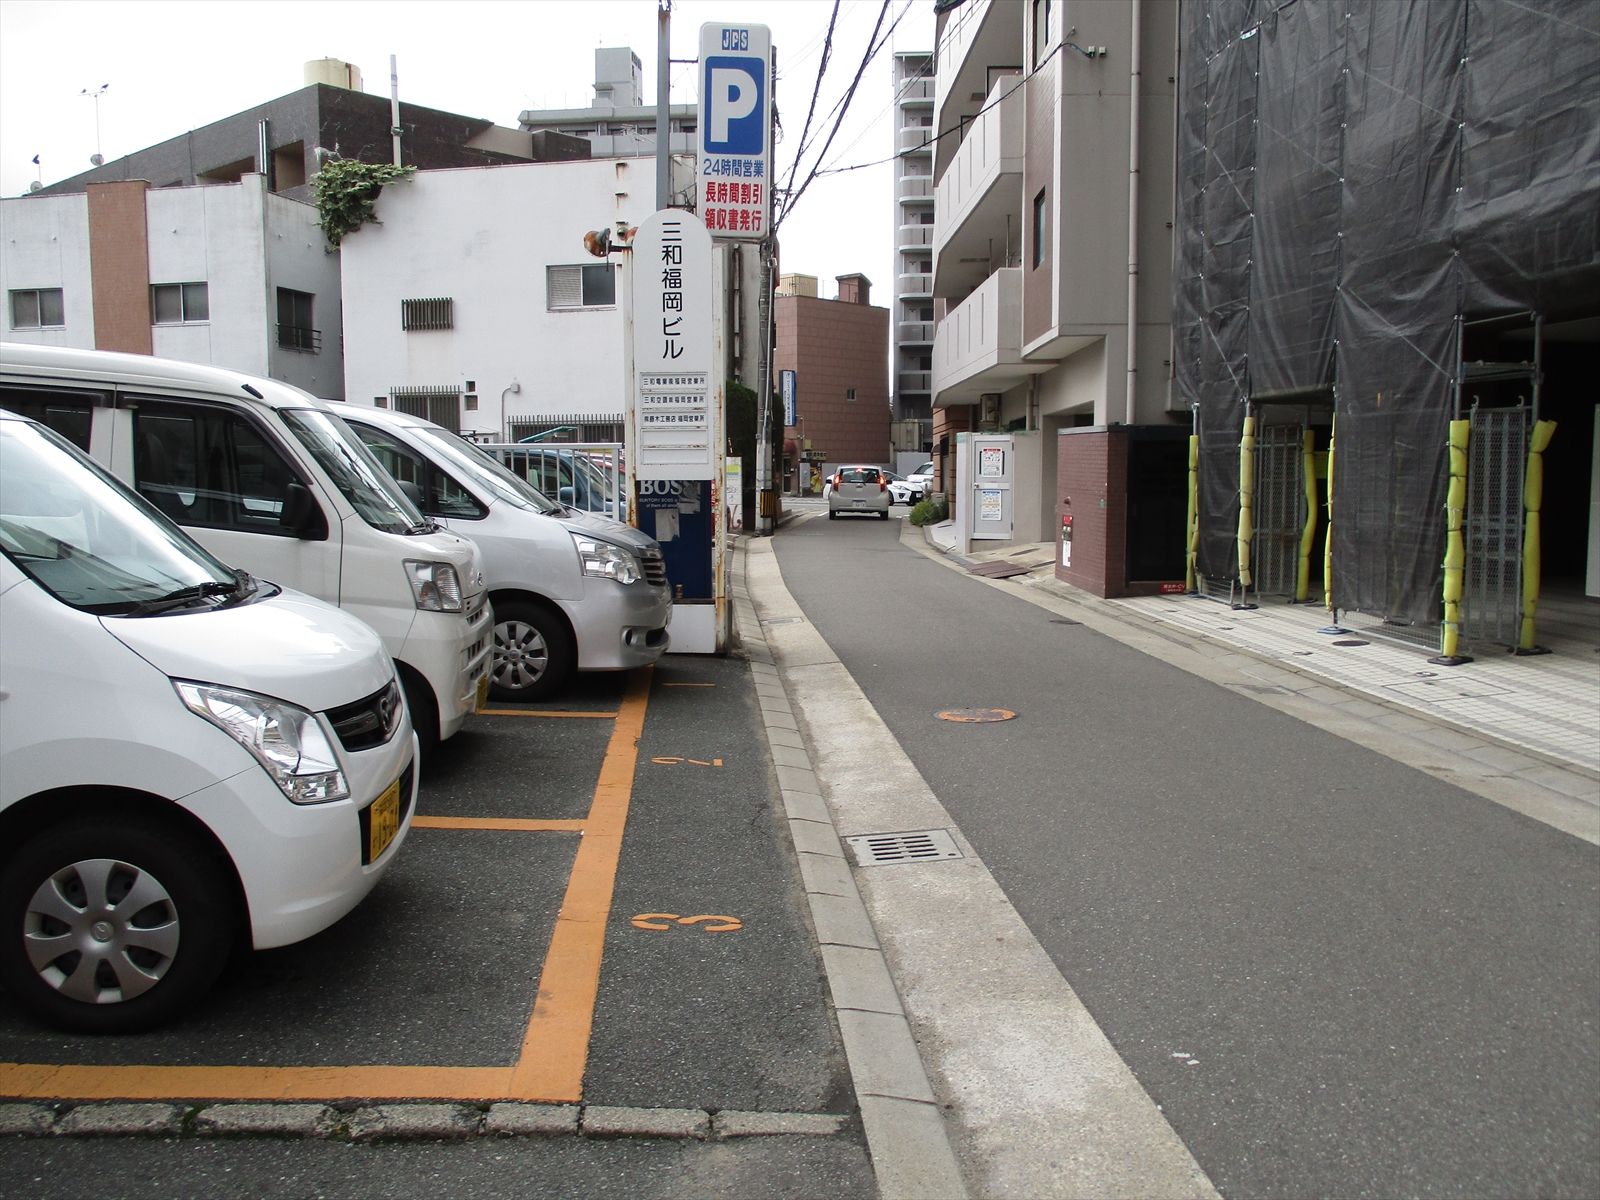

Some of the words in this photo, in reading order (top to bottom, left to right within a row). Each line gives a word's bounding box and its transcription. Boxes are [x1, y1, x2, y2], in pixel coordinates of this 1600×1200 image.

[723, 30, 748, 50] JPS
[710, 68, 758, 143] P
[703, 158, 764, 178] 24時間営業
[705, 181, 763, 205] 長時間割引
[705, 208, 762, 232] 領収書発行
[661, 222, 684, 360] 三和福岡ビル
